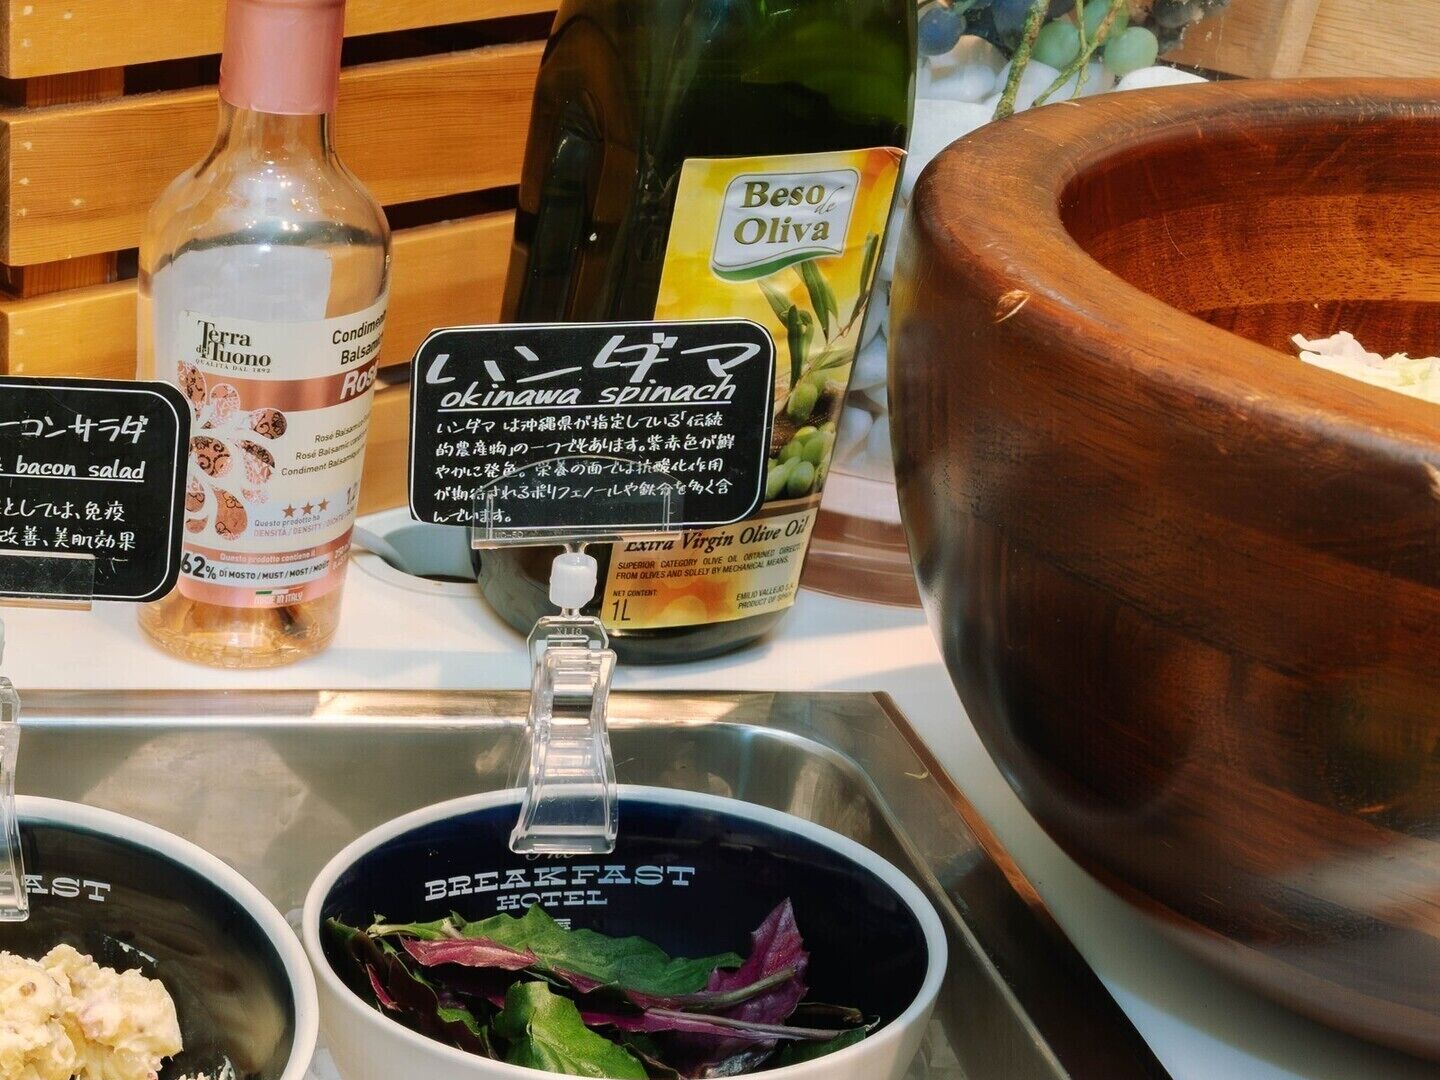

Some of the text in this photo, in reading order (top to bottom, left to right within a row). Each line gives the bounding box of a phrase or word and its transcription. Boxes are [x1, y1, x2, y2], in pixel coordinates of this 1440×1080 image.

[740, 181, 825, 208] Beso
[733, 216, 829, 245] Oliva
[197, 320, 252, 350] Terra
[210, 343, 272, 367] Tuono
[426, 332, 761, 385] ハンダマ
[440, 374, 738, 408] okinawa spinach
[295, 449, 317, 460] Rosé
[16, 459, 77, 477] bacon
[88, 461, 146, 480] salad
[281, 463, 327, 476] Condiment
[254, 518, 280, 527] Questo
[282, 516, 312, 528] prodotto
[433, 507, 512, 524] んでいます。
[681, 530, 733, 554] Virgin
[739, 525, 782, 548] Olive
[785, 516, 809, 537] Oil
[180, 552, 217, 580] 62%
[219, 552, 247, 562] Questo
[618, 560, 656, 570] SUPERIOR
[661, 558, 698, 569] CATEGORY
[703, 556, 724, 565] OLIVE
[727, 555, 738, 563] OIL
[228, 569, 256, 580] MOSTO
[262, 569, 283, 580] MUST
[290, 567, 309, 578] MOST
[616, 571, 638, 580] FROM
[639, 570, 665, 580] OLIVES
[667, 569, 683, 578] AND
[711, 566, 721, 575] BY
[722, 561, 764, 574] MECHANICAL
[736, 586, 784, 602] EMILIO VALLEJO
[612, 598, 631, 621] 1L
[424, 864, 696, 902] BREAKFAST
[496, 890, 608, 911] HOTEL
